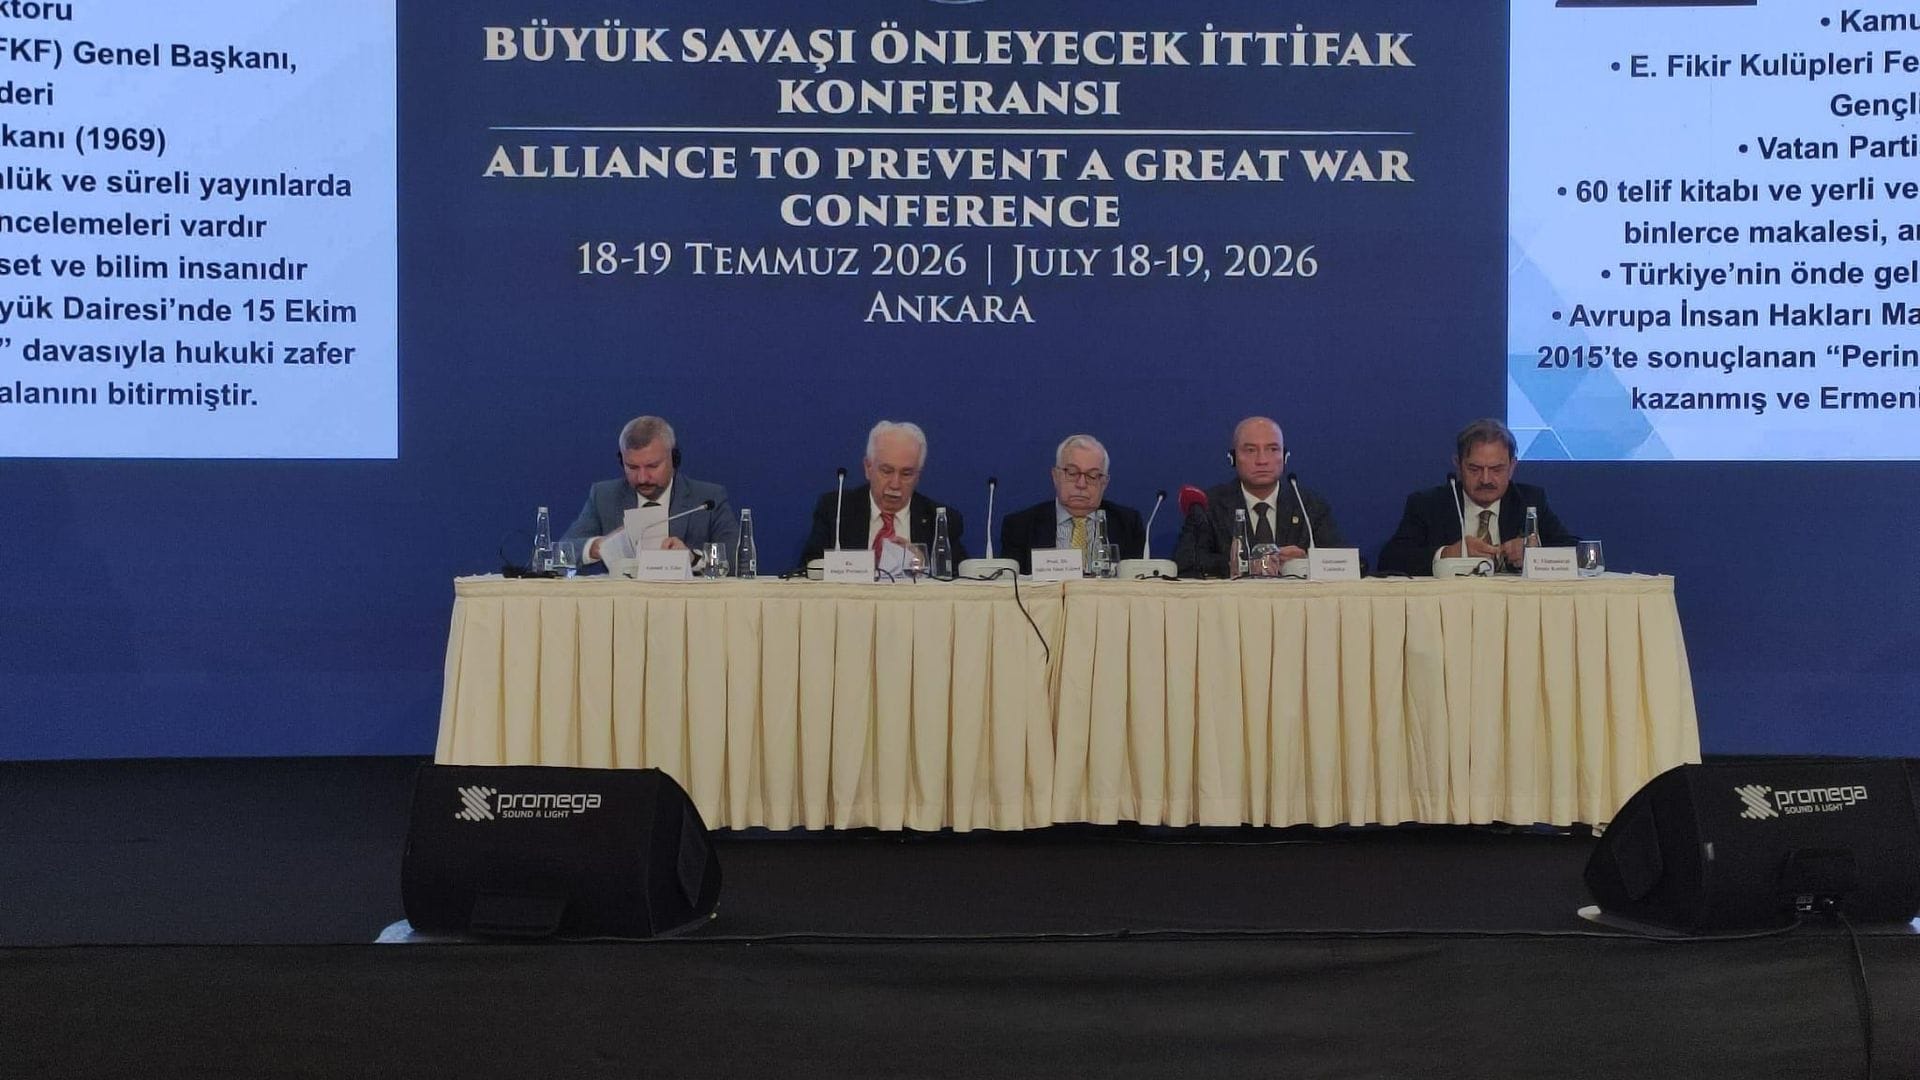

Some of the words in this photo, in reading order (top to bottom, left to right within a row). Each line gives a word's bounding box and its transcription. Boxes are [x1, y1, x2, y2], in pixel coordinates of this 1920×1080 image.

[74, 41, 159, 66] Genel
[171, 44, 296, 74] Başkanı,
[484, 19, 672, 62] BÜYÜK
[682, 28, 856, 73] SAVAŞI
[871, 22, 1190, 65] ÖNLEYECEK
[1200, 23, 1416, 66] İTTİFAK
[1631, 55, 1656, 77] E.
[1668, 55, 1731, 77] Fikir
[1741, 51, 1872, 81] Kulüpleri
[1885, 51, 1919, 73] Fe
[0, 81, 53, 105] deri
[778, 80, 1120, 115] KONFERANSI
[1831, 92, 1920, 121] Gençl
[2, 123, 64, 148] kanı
[76, 126, 165, 157] (1969)
[1758, 137, 1838, 159] Vatan
[1850, 134, 1917, 158] Parti
[483, 146, 737, 178] ALLIANCE
[751, 147, 819, 179] TO
[835, 148, 1067, 180] PREVENT
[1077, 149, 1113, 180] A
[1125, 149, 1289, 181] GREAT
[1301, 150, 1414, 181] WAR
[0, 166, 52, 191] lük
[62, 175, 96, 192] ve
[107, 170, 189, 194] süreli
[200, 173, 351, 201] yayınlarda
[1577, 180, 1608, 202] 60
[1618, 179, 1672, 202] telif
[1681, 179, 1758, 202] kitabı
[1768, 184, 1801, 201] ve
[1811, 177, 1873, 207] yerli
[1884, 182, 1918, 199] ve
[0, 211, 169, 236] ncelemeleri
[180, 215, 267, 237] vardır
[781, 194, 1120, 227] CONFERENCE
[1625, 221, 1739, 244] binlerce
[1750, 219, 1886, 246] makalesi,
[1898, 224, 1920, 241] a
[0, 254, 41, 276] set
[51, 260, 85, 277] ve
[97, 255, 168, 278] bilim
[180, 256, 308, 280] insanıdır
[579, 242, 671, 274] 18-19
[685, 243, 859, 275] TEMMUZ
[872, 244, 966, 275] 2026
[1012, 245, 1101, 285] JULY
[1112, 245, 1209, 281] 18-19,
[1225, 245, 1317, 276] 2026
[1620, 262, 1780, 291] Türkiye’nin
[1791, 261, 1864, 284] önde
[1875, 260, 1918, 289] gel
[0, 295, 53, 323] yük
[64, 296, 231, 321] Dairesi’nde
[243, 299, 275, 322] 15
[286, 299, 356, 322] Ekim
[864, 291, 1035, 322] ANKARA
[1569, 304, 1670, 332] Avrupa
[1682, 299, 1758, 326] İnsan
[1770, 303, 1870, 326] Hakları
[1882, 302, 1920, 325] Ma
[23, 338, 165, 369] davasıyla
[176, 340, 273, 364] hukuki
[284, 342, 356, 364] zafer
[1537, 346, 1638, 368] 2015’te
[1648, 345, 1815, 374] sonuçlanan
[1827, 344, 1918, 367] “Perin
[0, 381, 96, 404] alanını
[109, 382, 257, 411] bitirmiştir.
[1632, 387, 1767, 415] kazanmış
[1776, 392, 1809, 409] ve
[1821, 387, 1920, 409] Ermen
[497, 794, 602, 813] promega
[1774, 786, 1867, 810] promega
[1785, 804, 1813, 814] SOUND
[502, 810, 534, 818] SOUND
[544, 810, 570, 818] LIGHT
